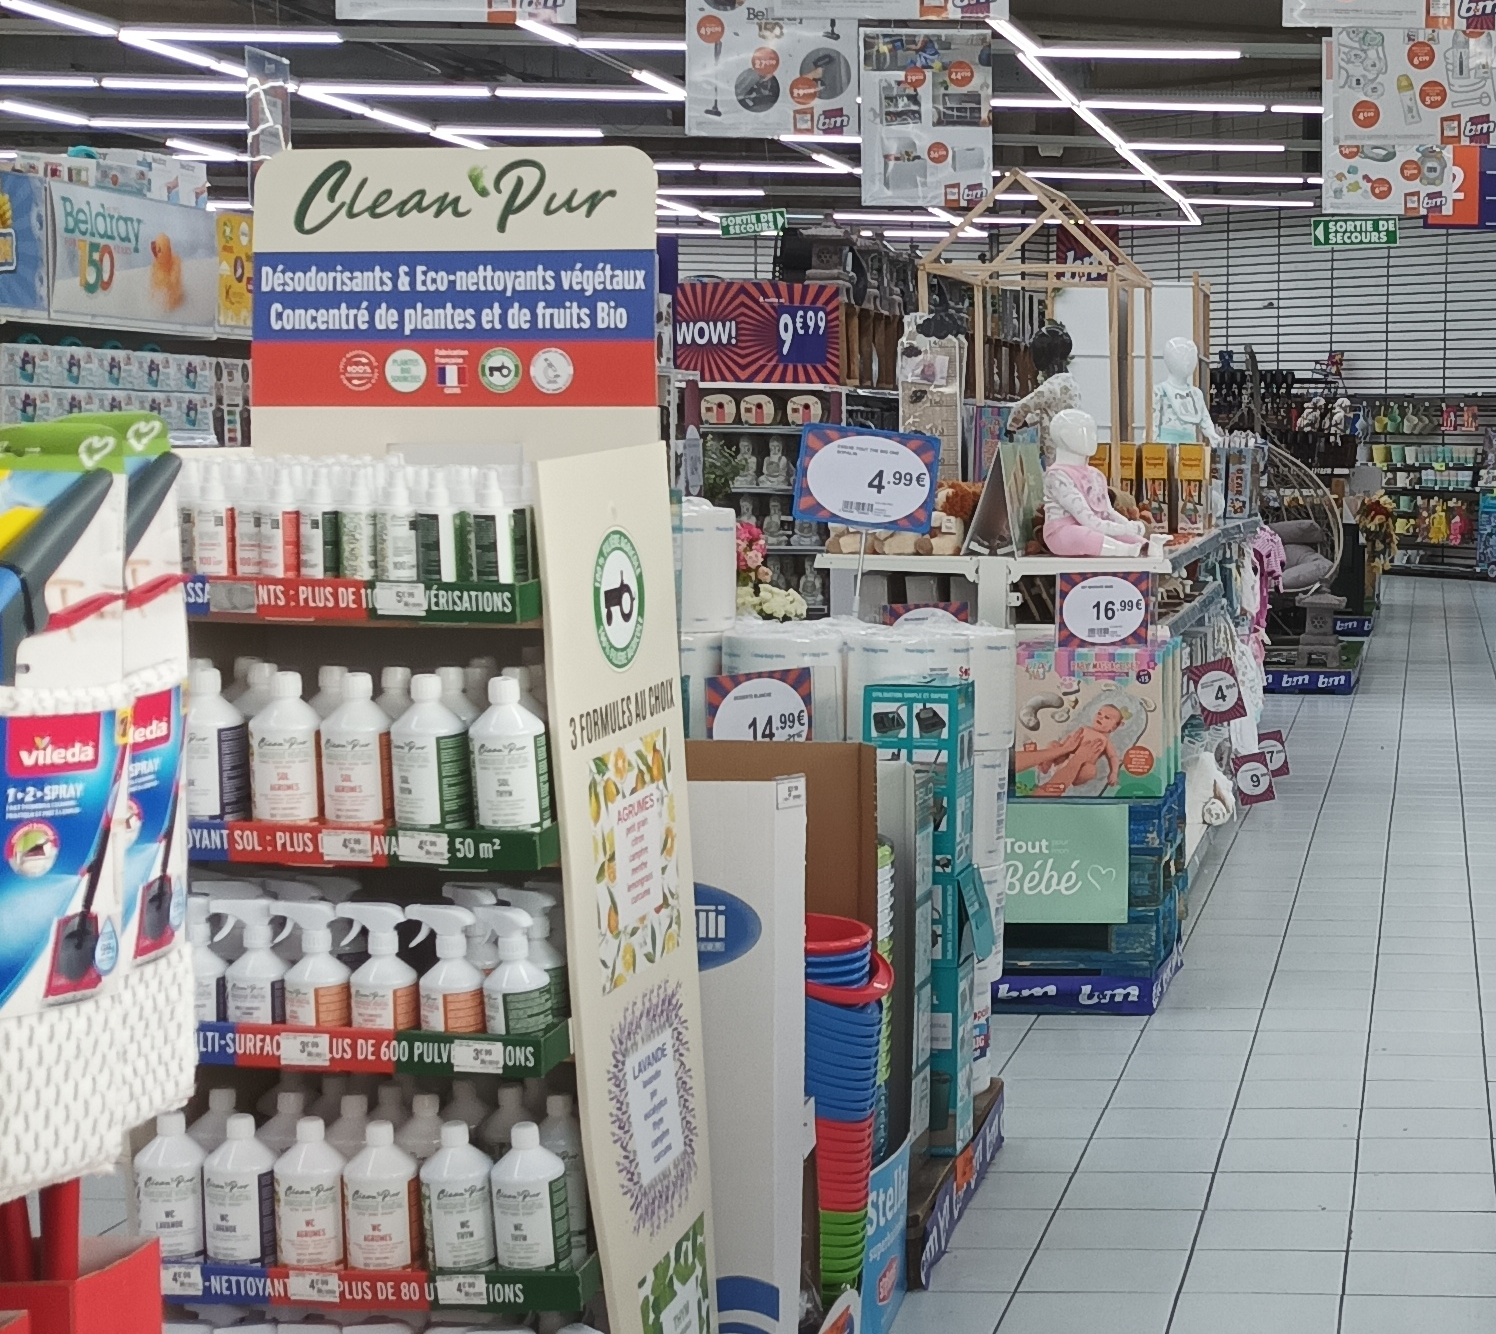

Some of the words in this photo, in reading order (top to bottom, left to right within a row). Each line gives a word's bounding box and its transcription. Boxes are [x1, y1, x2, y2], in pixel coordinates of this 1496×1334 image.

[294, 159, 471, 235] Clean
[493, 159, 617, 234] Pur
[61, 196, 143, 253] Beldray
[721, 213, 755, 227] SORTIE
[758, 210, 774, 223] DE
[729, 220, 775, 234] SECOURS
[1328, 220, 1377, 233] SORTIE
[1380, 219, 1395, 232] DE
[1328, 230, 1389, 244] SECOURS
[78, 240, 115, 295] 150
[261, 265, 393, 293] Désodorisants
[398, 266, 410, 292] &
[415, 265, 556, 296] Eco-nettoyants
[561, 263, 646, 296] végétaux
[270, 302, 369, 330] Concentré
[374, 303, 399, 330] de
[404, 302, 476, 335] plantes
[481, 303, 502, 330] et
[508, 302, 531, 329] de
[537, 301, 590, 329] fruits
[596, 302, 627, 329] Bio
[677, 320, 738, 346] WOW!
[779, 310, 827, 354] 9€99
[298, 585, 334, 609] PLUS
[338, 586, 358, 609] DE
[569, 716, 578, 751] 3
[579, 699, 633, 747] FORMULES
[635, 693, 647, 722] AU
[648, 677, 676, 719] CHOIX
[18, 735, 95, 768] vileda
[617, 793, 655, 825] AGRUMES
[234, 830, 262, 853] SOL
[276, 831, 314, 854] PLUS
[455, 837, 474, 858] 50
[1004, 837, 1049, 856] Tout
[1004, 859, 1084, 897] Bébé
[357, 1039, 377, 1061] DE
[381, 1040, 411, 1062] 600
[632, 1042, 668, 1081] LAVANDE
[338, 1280, 372, 1303] PLUS
[376, 1281, 396, 1303] DE
[400, 1280, 420, 1303] 80
